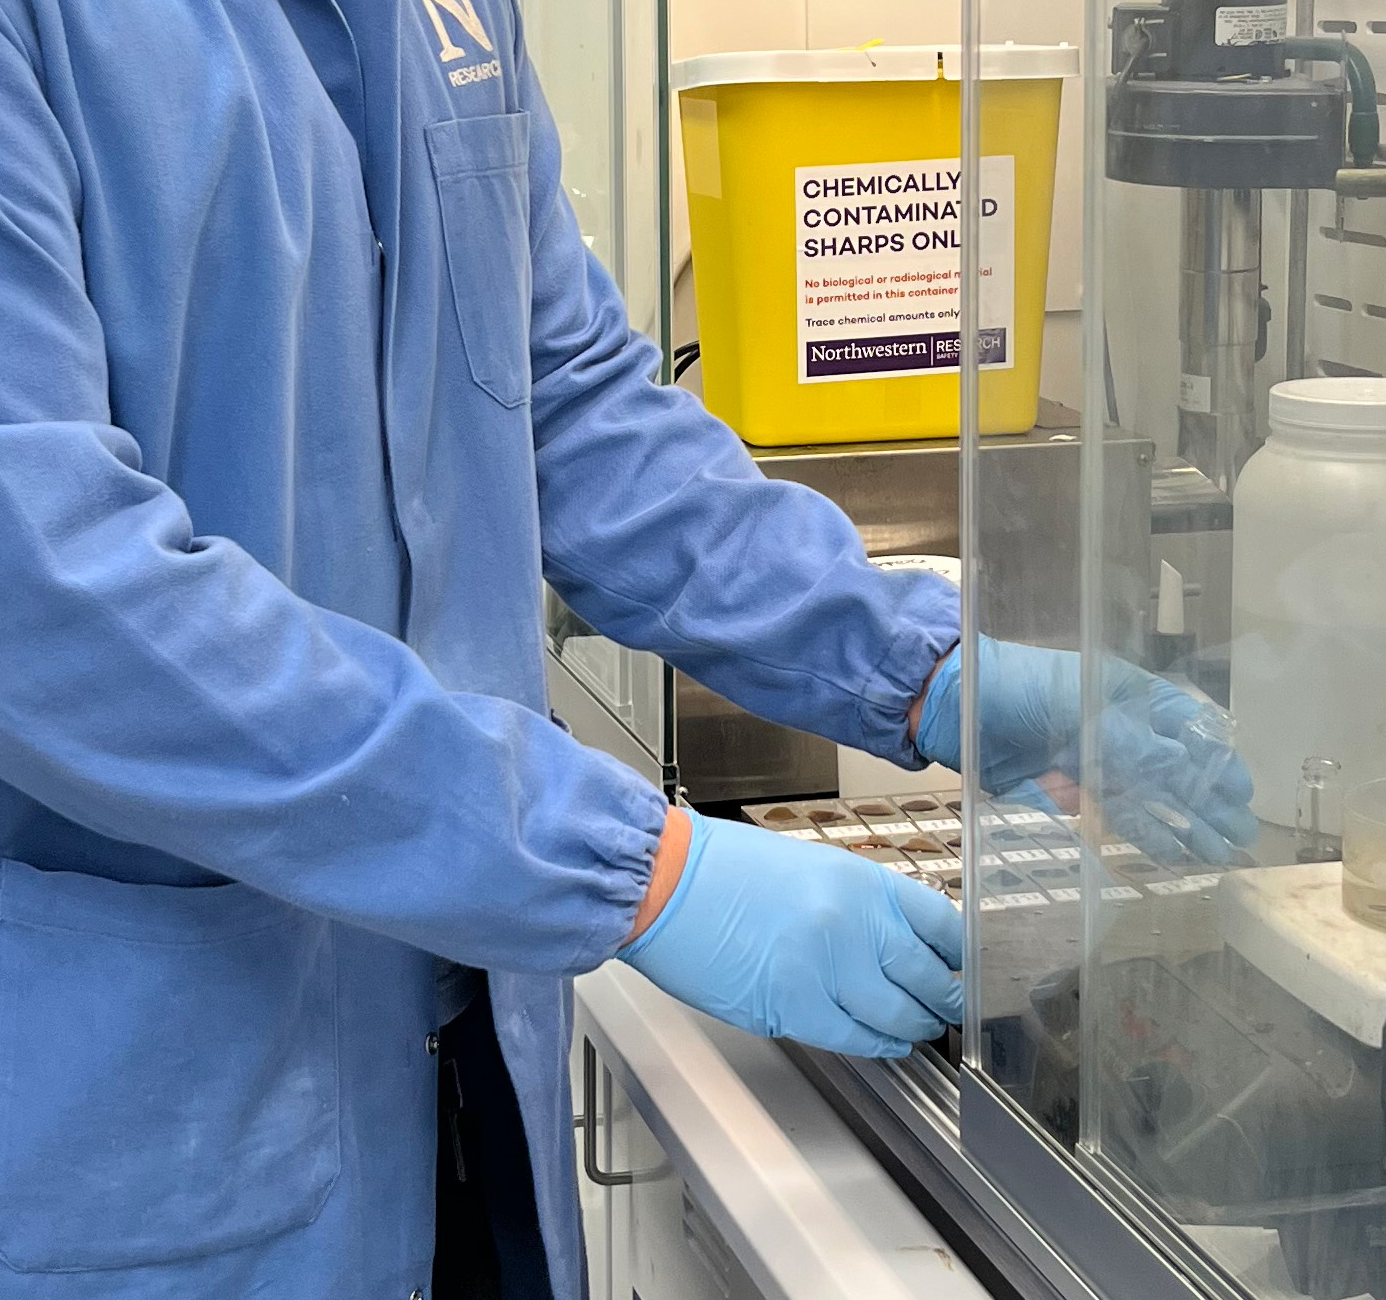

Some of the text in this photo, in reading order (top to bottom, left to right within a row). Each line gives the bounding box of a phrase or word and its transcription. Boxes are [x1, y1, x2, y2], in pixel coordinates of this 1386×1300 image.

[448, 59, 502, 88] RESEARC
[803, 171, 961, 199] CHEMICALLY
[803, 198, 998, 229] CONTAMINAD
[804, 230, 962, 258] SHARPS ONL
[805, 280, 820, 289] No
[822, 274, 874, 290] biological
[876, 276, 887, 285] or
[890, 270, 952, 285] radiological
[816, 291, 870, 306] permitted
[872, 289, 883, 300] in
[885, 288, 906, 299] this
[805, 318, 836, 328] Trace
[837, 313, 886, 326] chemical
[888, 310, 936, 322] amounts
[811, 341, 928, 363] Northwestern
